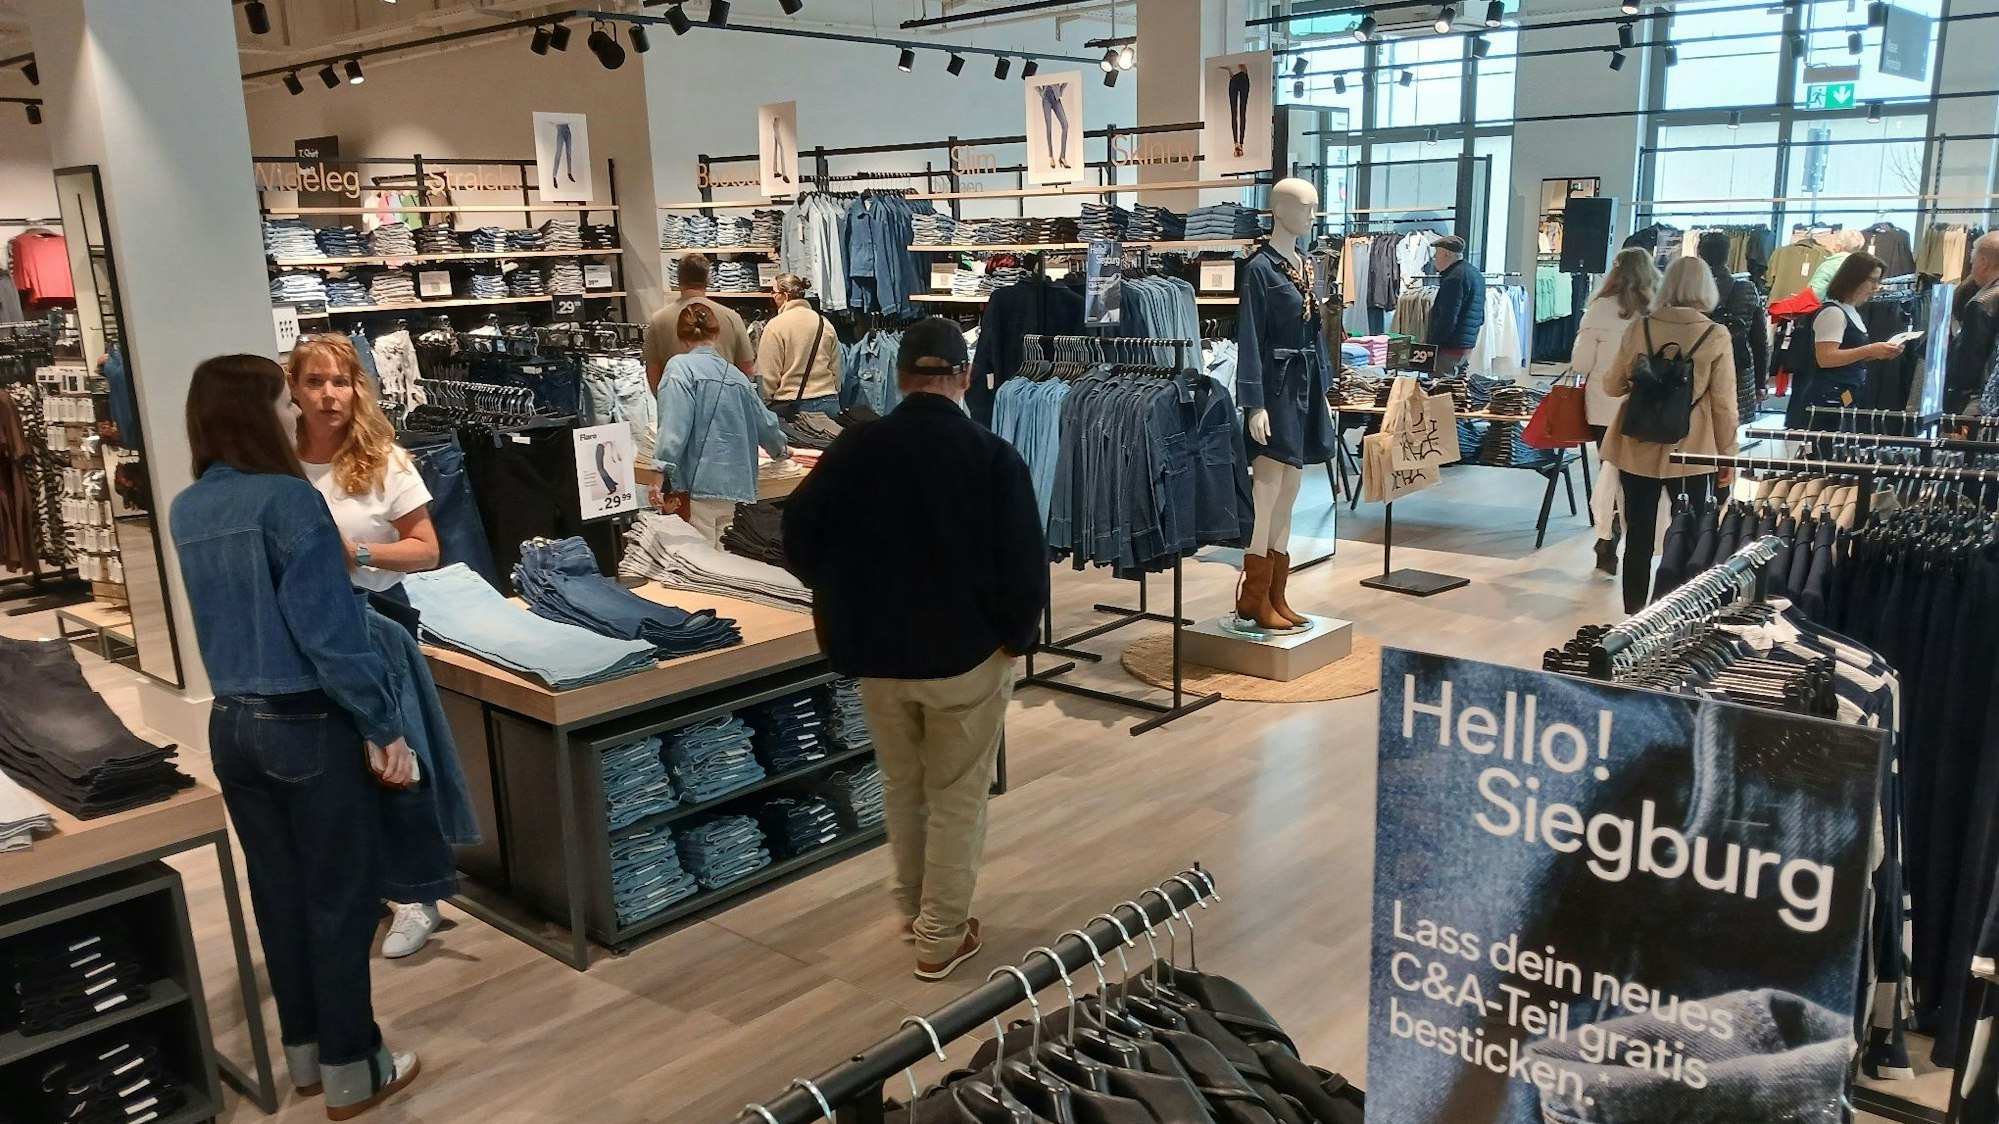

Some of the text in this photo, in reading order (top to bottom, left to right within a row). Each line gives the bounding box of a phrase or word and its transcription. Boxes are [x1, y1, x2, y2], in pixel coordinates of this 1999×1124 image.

[950, 145, 996, 176] Slim
[1110, 133, 1195, 172] Skinny
[1401, 673, 1613, 781] Hello!
[1475, 766, 1835, 933] Siegburg
[1390, 951, 1710, 1091] C&A-Teil gratis
[1393, 899, 1735, 1042] Lass dein neues
